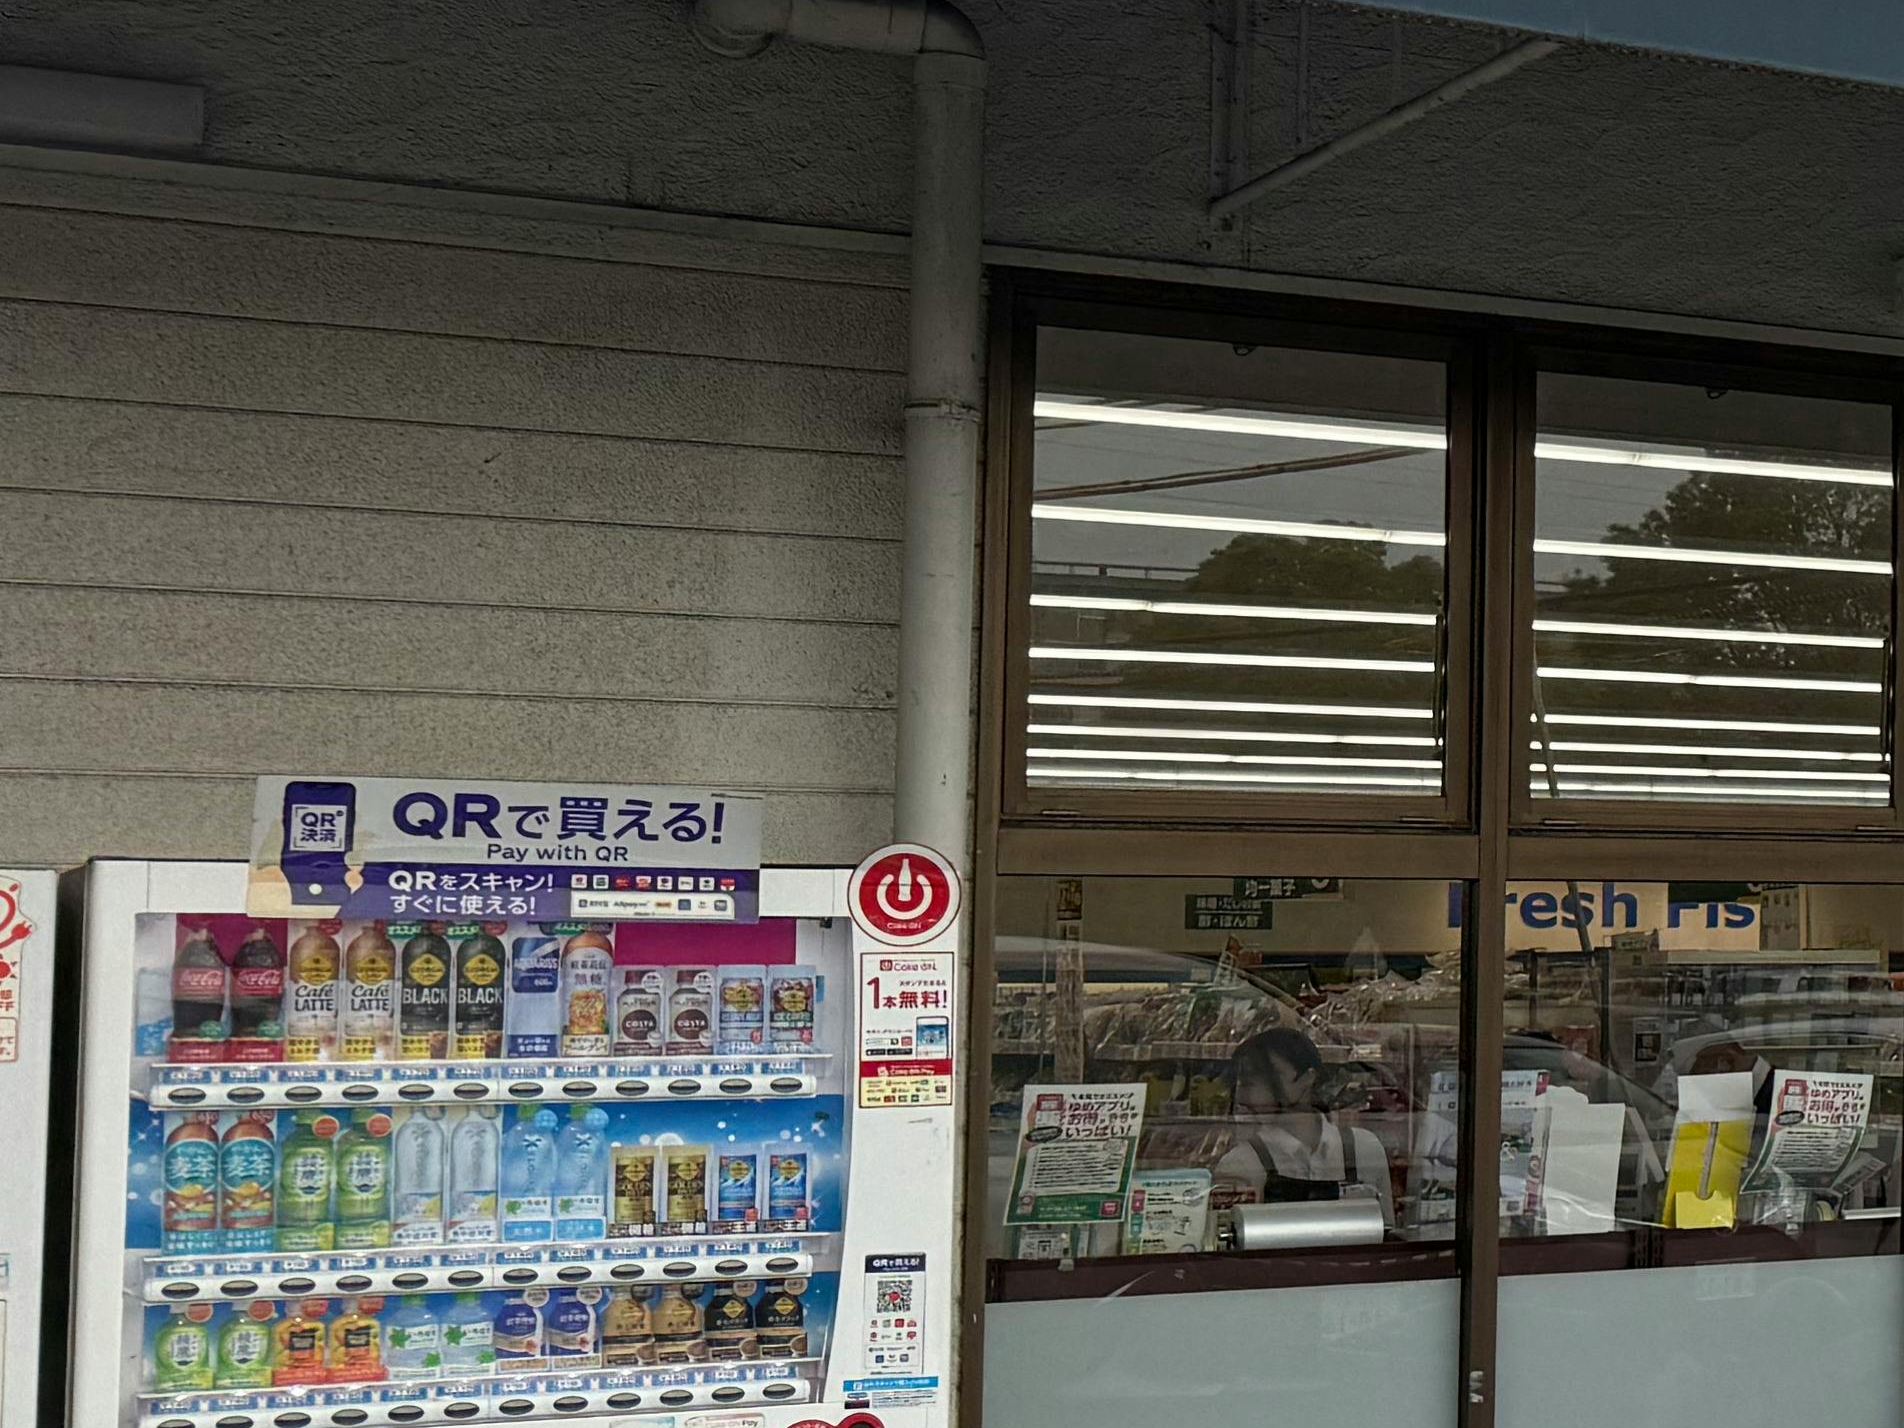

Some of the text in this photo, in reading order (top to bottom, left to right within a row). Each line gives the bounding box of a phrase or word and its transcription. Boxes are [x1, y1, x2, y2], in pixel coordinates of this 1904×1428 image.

[301, 811, 336, 828] QR
[393, 792, 725, 845] QRで買える!
[301, 828, 337, 843] 決済
[486, 843, 628, 863] Pay with QR
[388, 871, 553, 892] QRをスキャン!
[390, 895, 536, 916] すぐに使える!
[295, 984, 334, 998] Café
[351, 984, 389, 998] Café
[403, 987, 448, 1005] BLACK
[457, 987, 503, 1005] BLACK
[867, 977, 947, 1009] 1本無料!
[295, 1000, 334, 1011] LATTE
[351, 999, 389, 1011] LATTE
